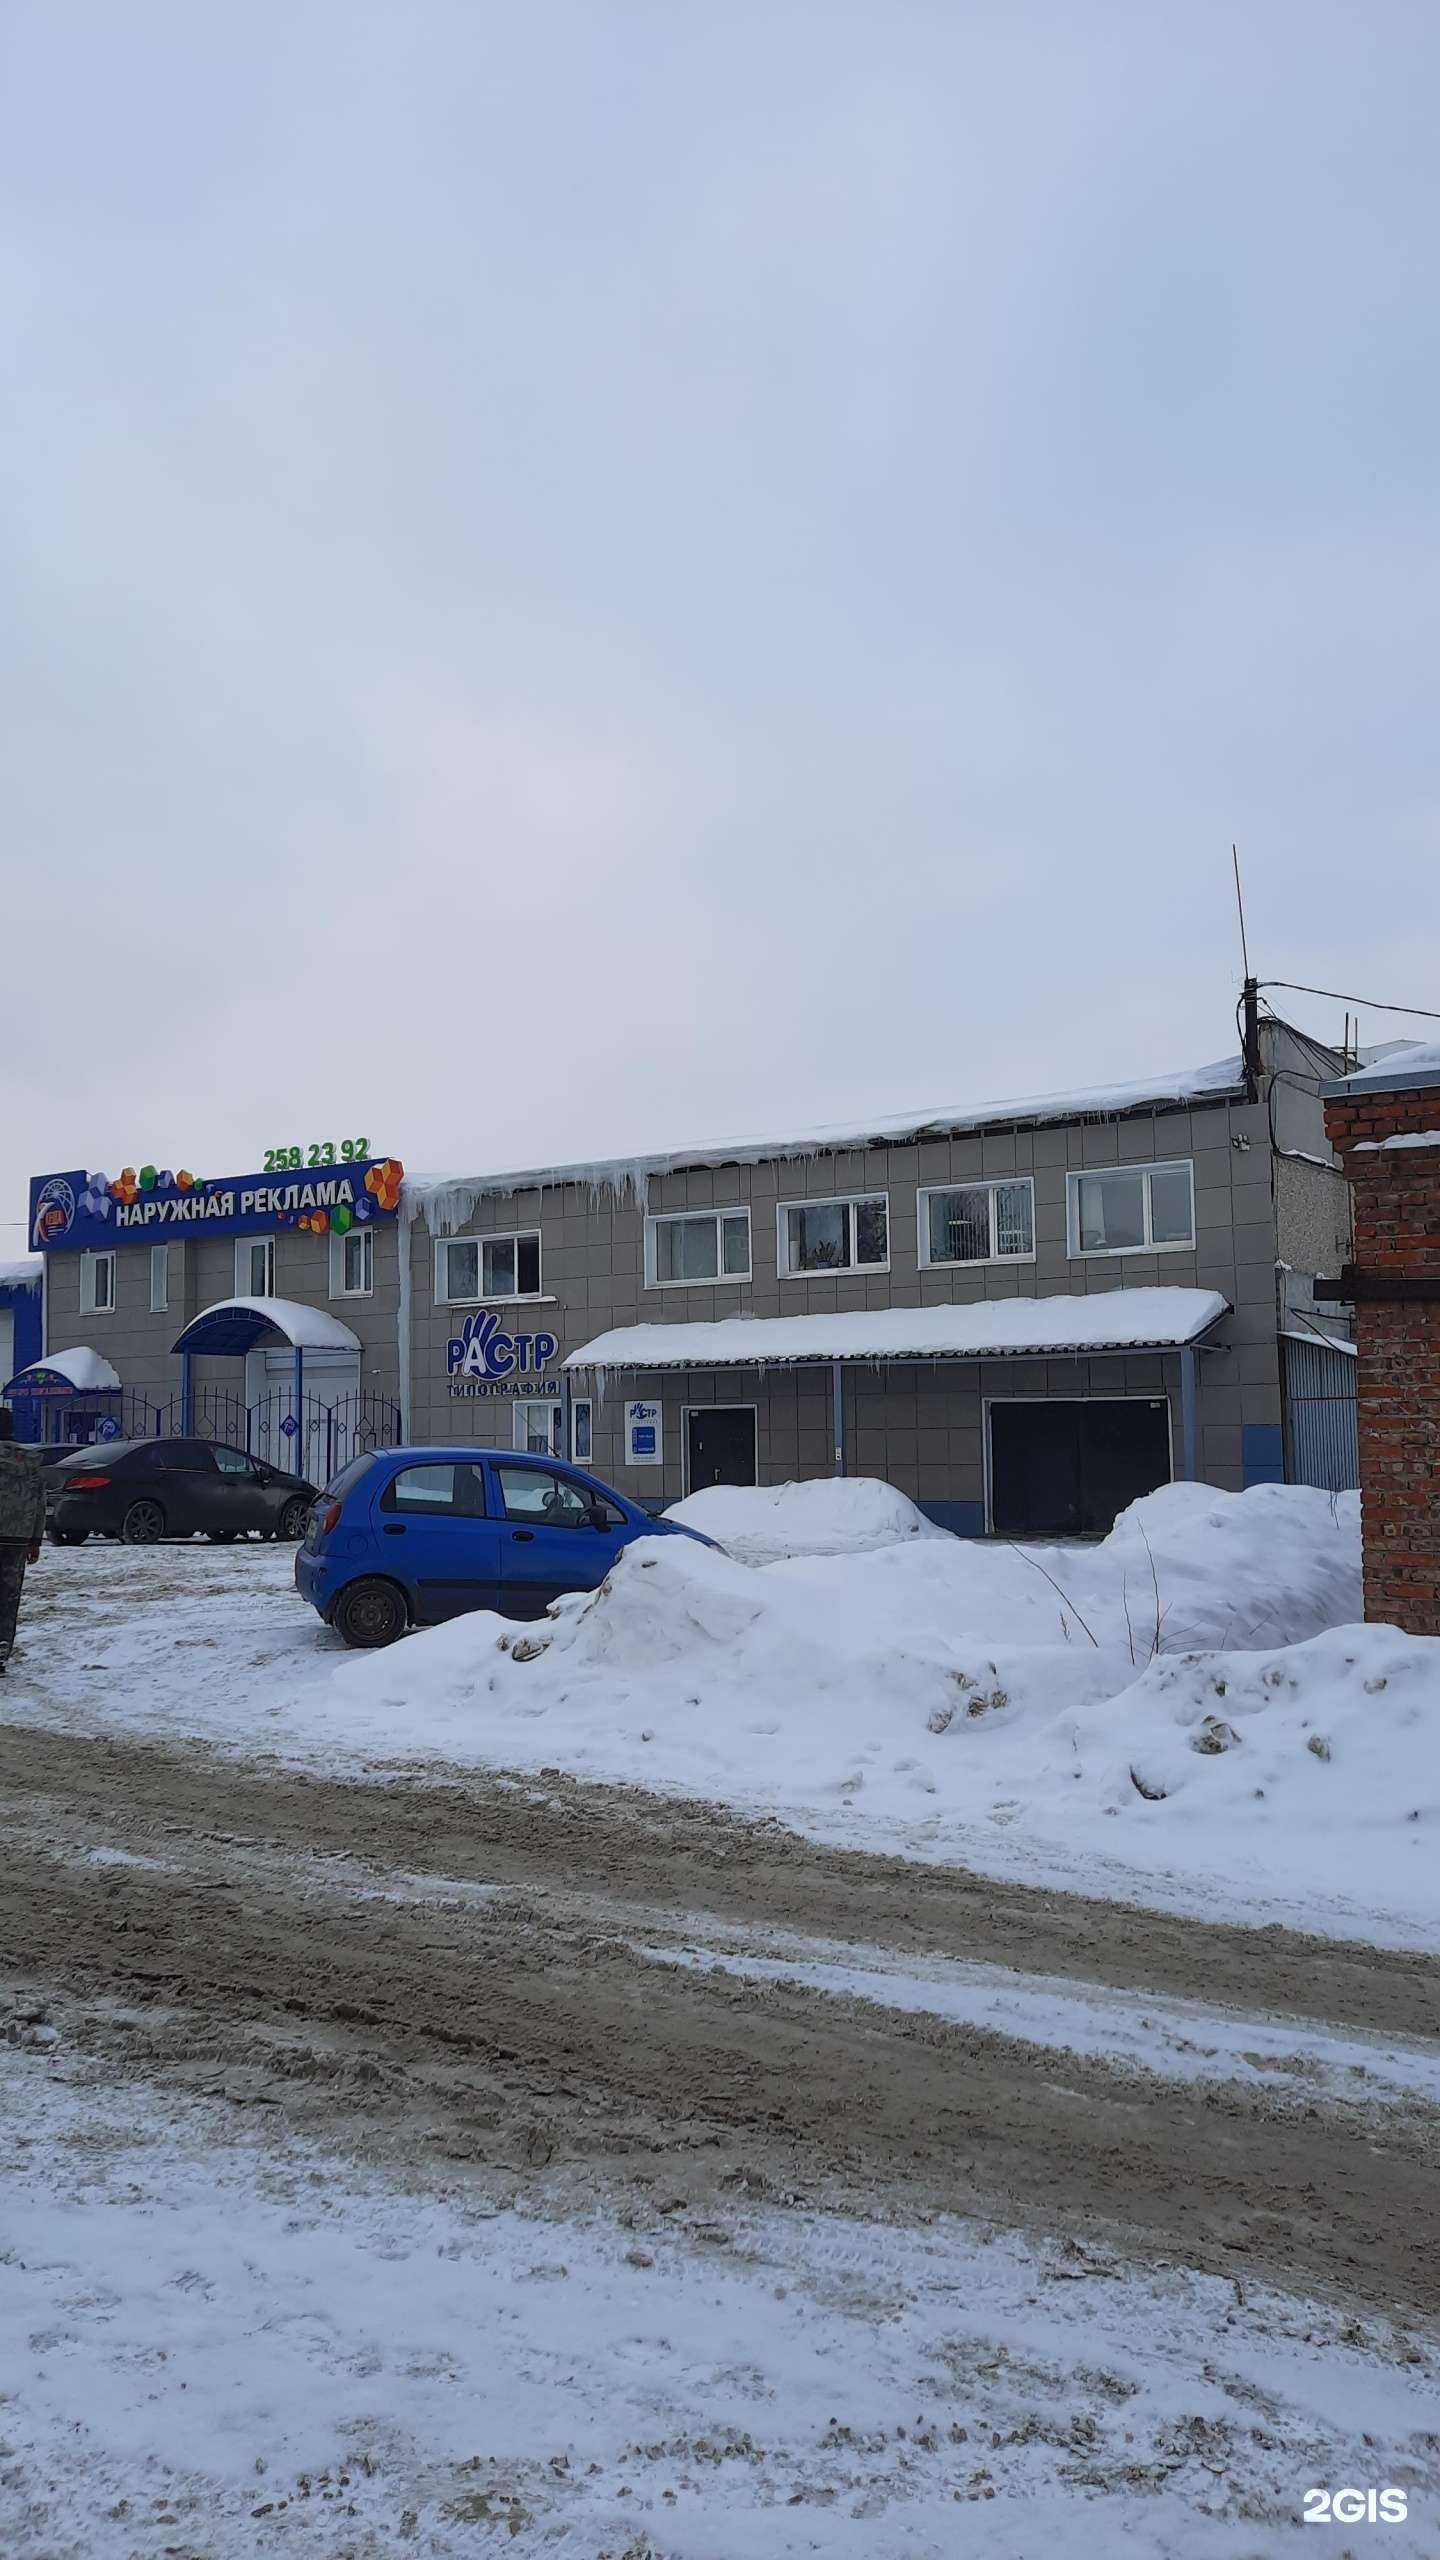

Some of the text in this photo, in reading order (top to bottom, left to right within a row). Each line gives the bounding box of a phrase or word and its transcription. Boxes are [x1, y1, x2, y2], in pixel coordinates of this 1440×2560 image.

[264, 1138, 370, 1172] 258 23 92
[116, 1179, 354, 1227] НАРУЖНАЯ РЕКЛАМА
[447, 1309, 559, 1380] РАСТР
[447, 1380, 560, 1398] ТИПОГРАФИЯ
